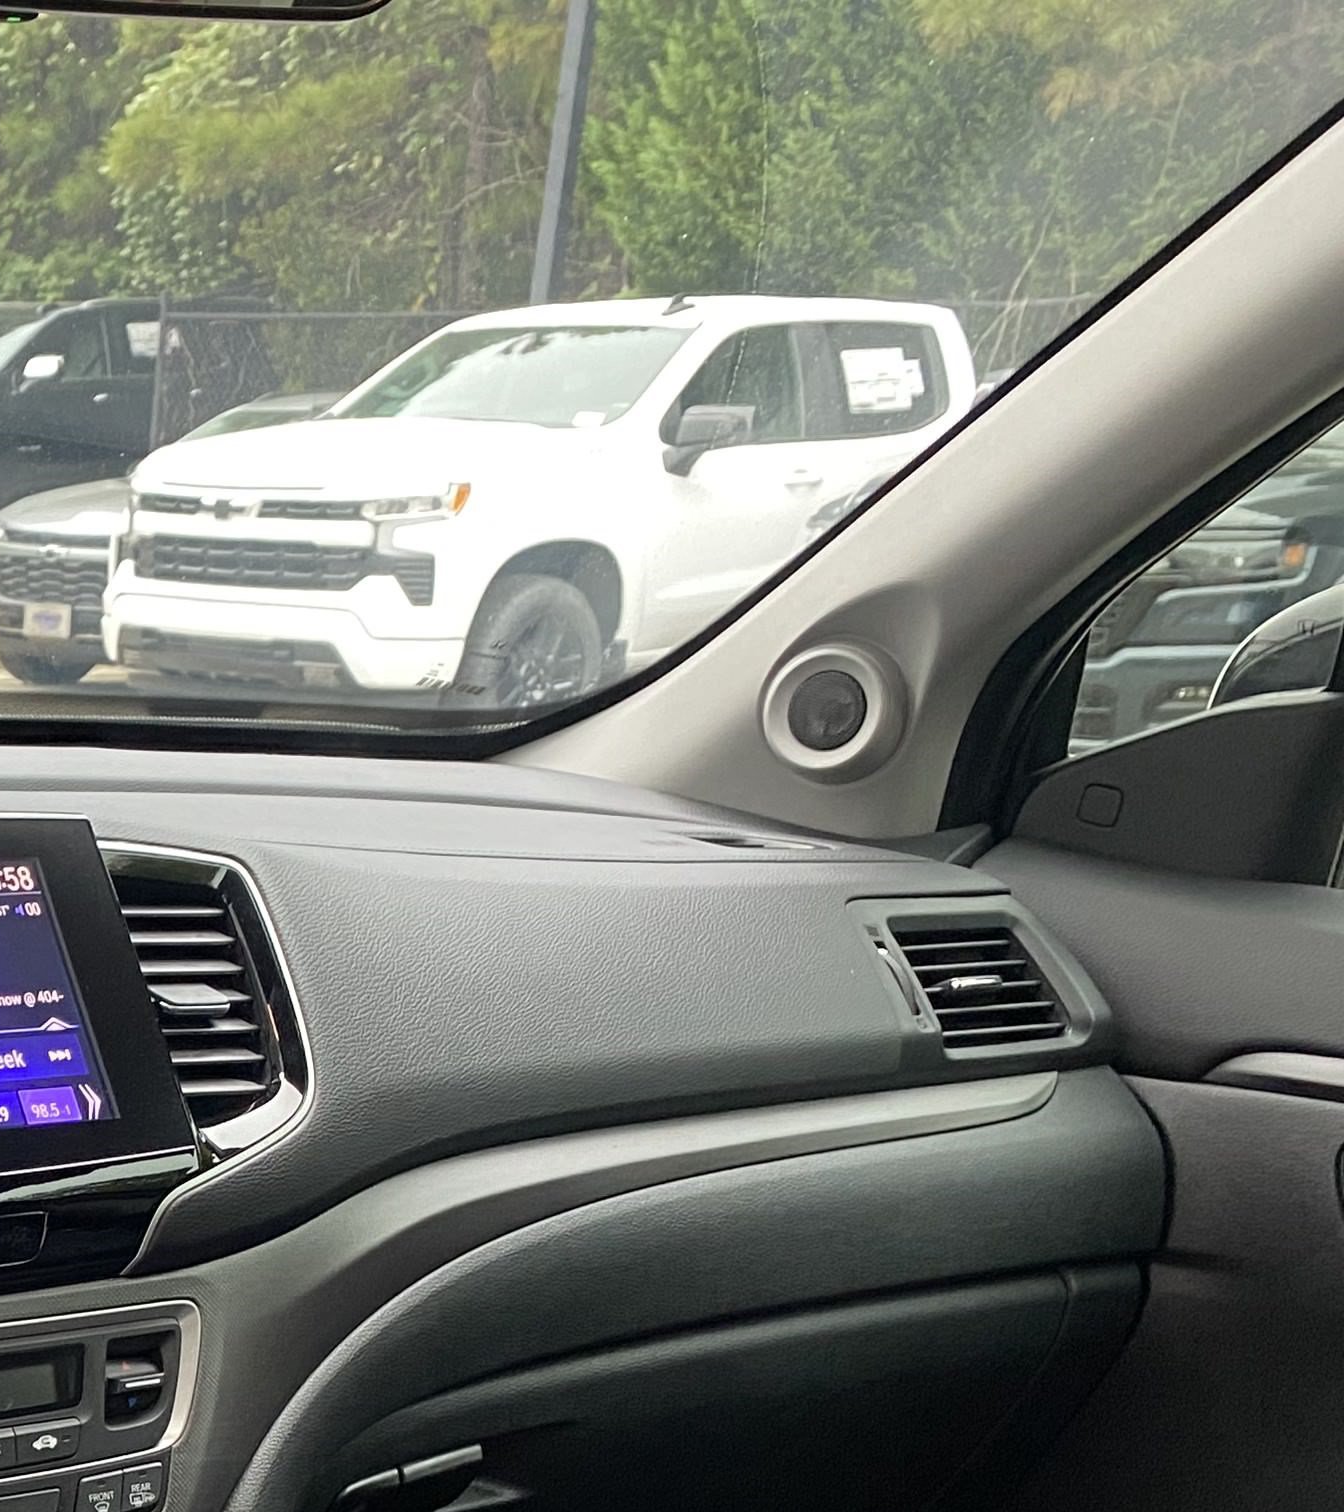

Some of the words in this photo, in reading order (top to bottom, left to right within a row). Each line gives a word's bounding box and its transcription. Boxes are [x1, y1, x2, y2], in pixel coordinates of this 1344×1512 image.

[23, 992, 36, 1007] @
[131, 1482, 151, 1493] REAR
[88, 1491, 114, 1503] FRONT
